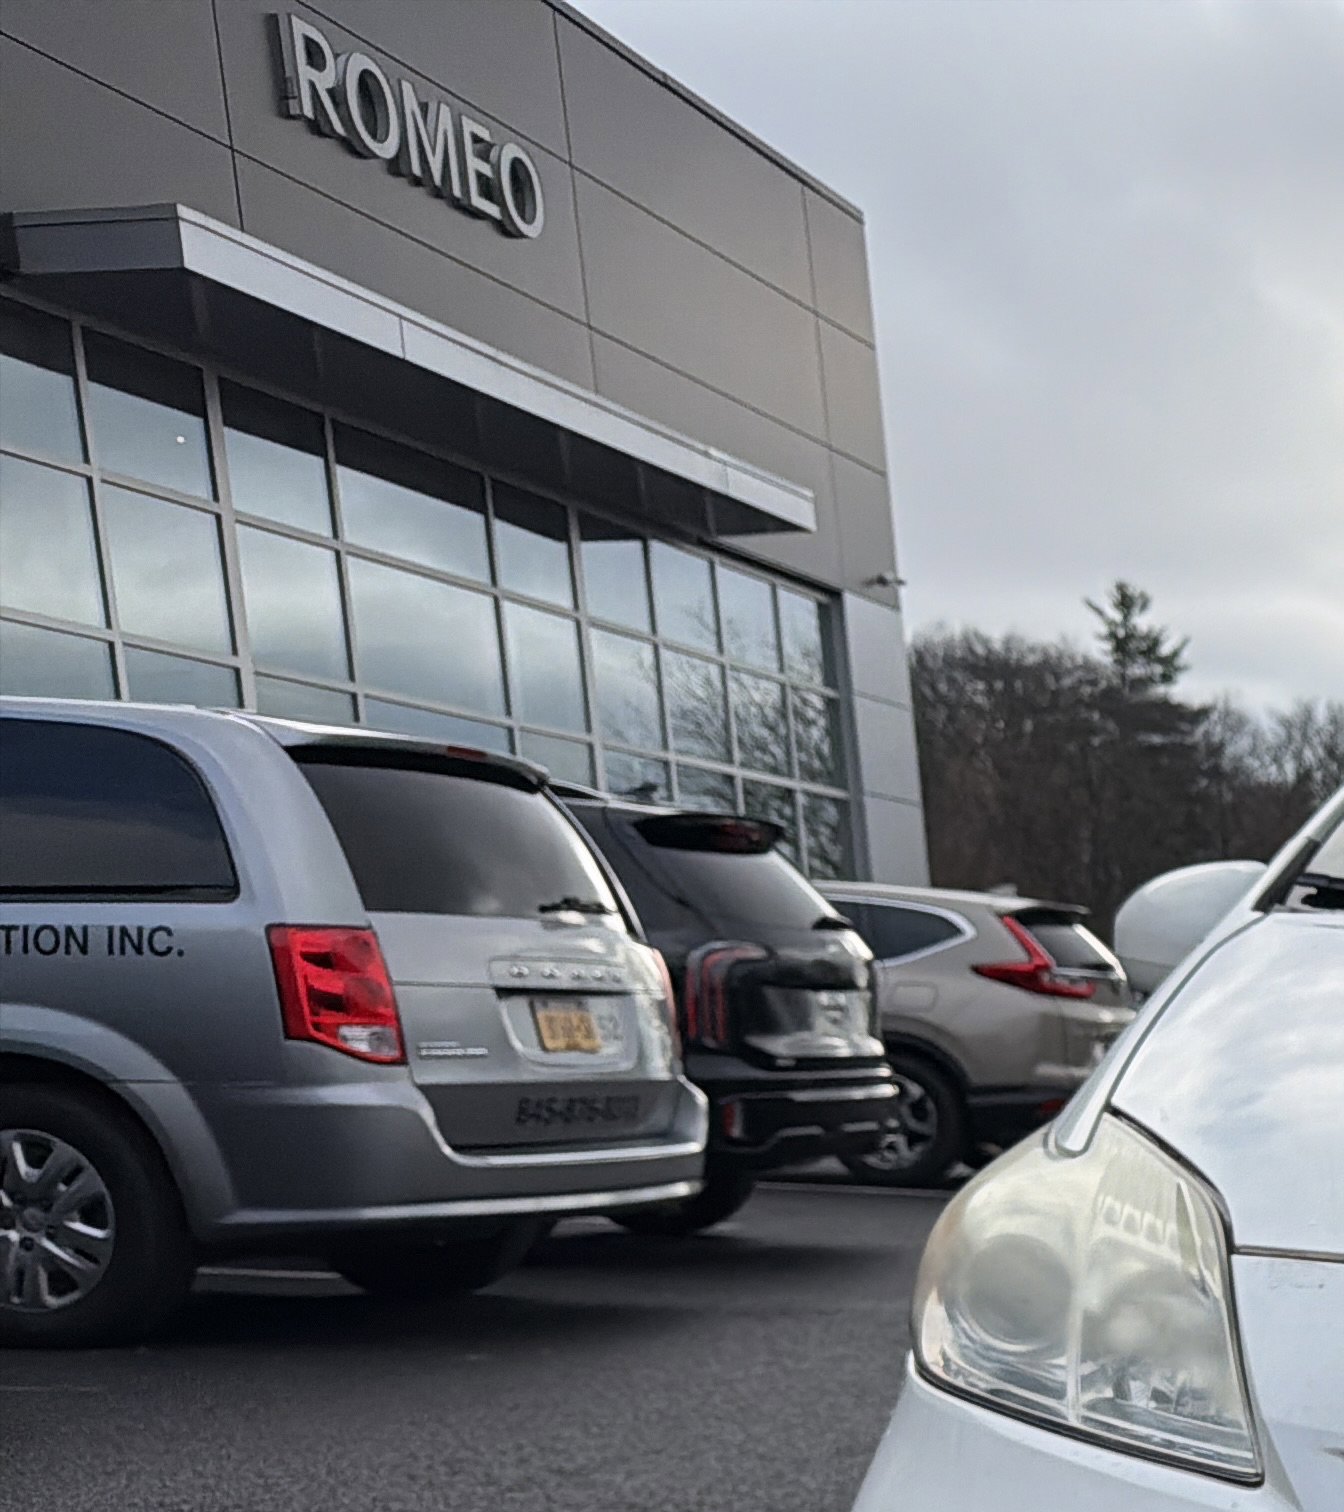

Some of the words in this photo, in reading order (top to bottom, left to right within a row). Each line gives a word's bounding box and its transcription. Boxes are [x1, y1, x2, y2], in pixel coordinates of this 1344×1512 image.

[284, 13, 545, 239] ROMEO
[0, 924, 89, 956] TION
[107, 924, 185, 957] INC.
